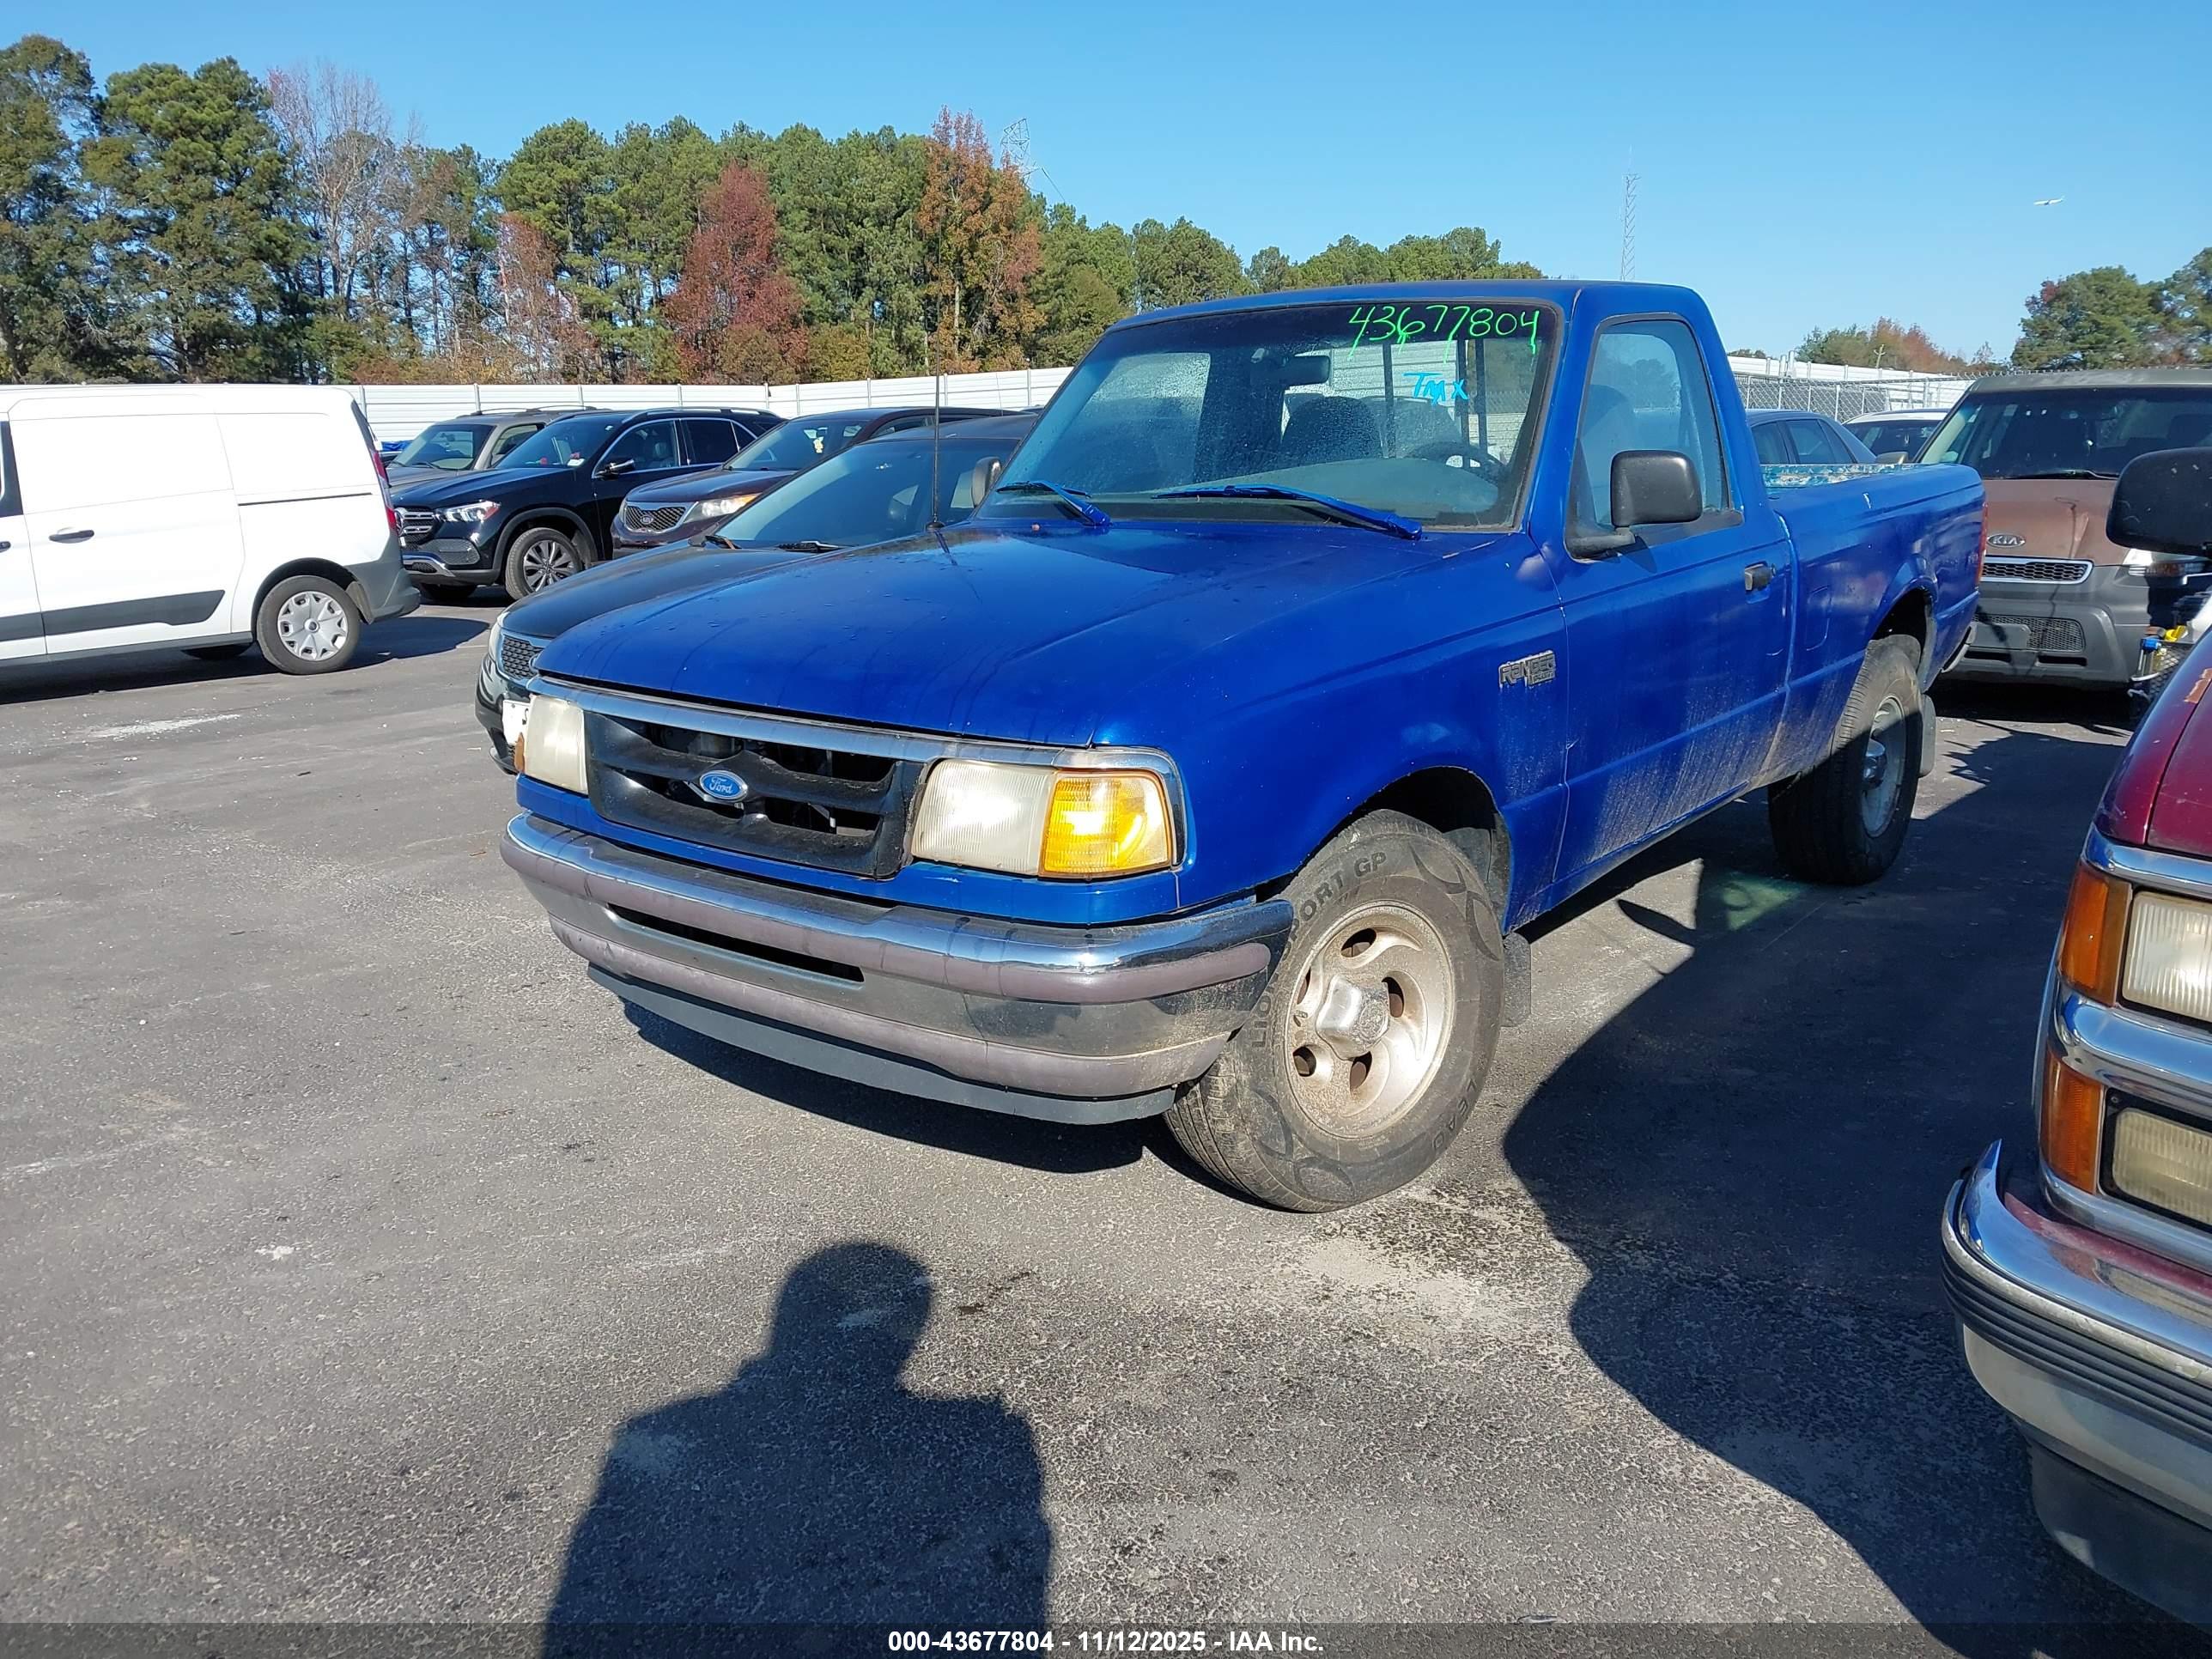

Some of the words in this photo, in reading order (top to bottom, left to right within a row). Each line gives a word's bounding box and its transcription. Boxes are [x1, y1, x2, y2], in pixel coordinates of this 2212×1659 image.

[1348, 305, 1540, 361] 43677804
[709, 776, 733, 793] Ford
[1353, 852, 1387, 877] GP
